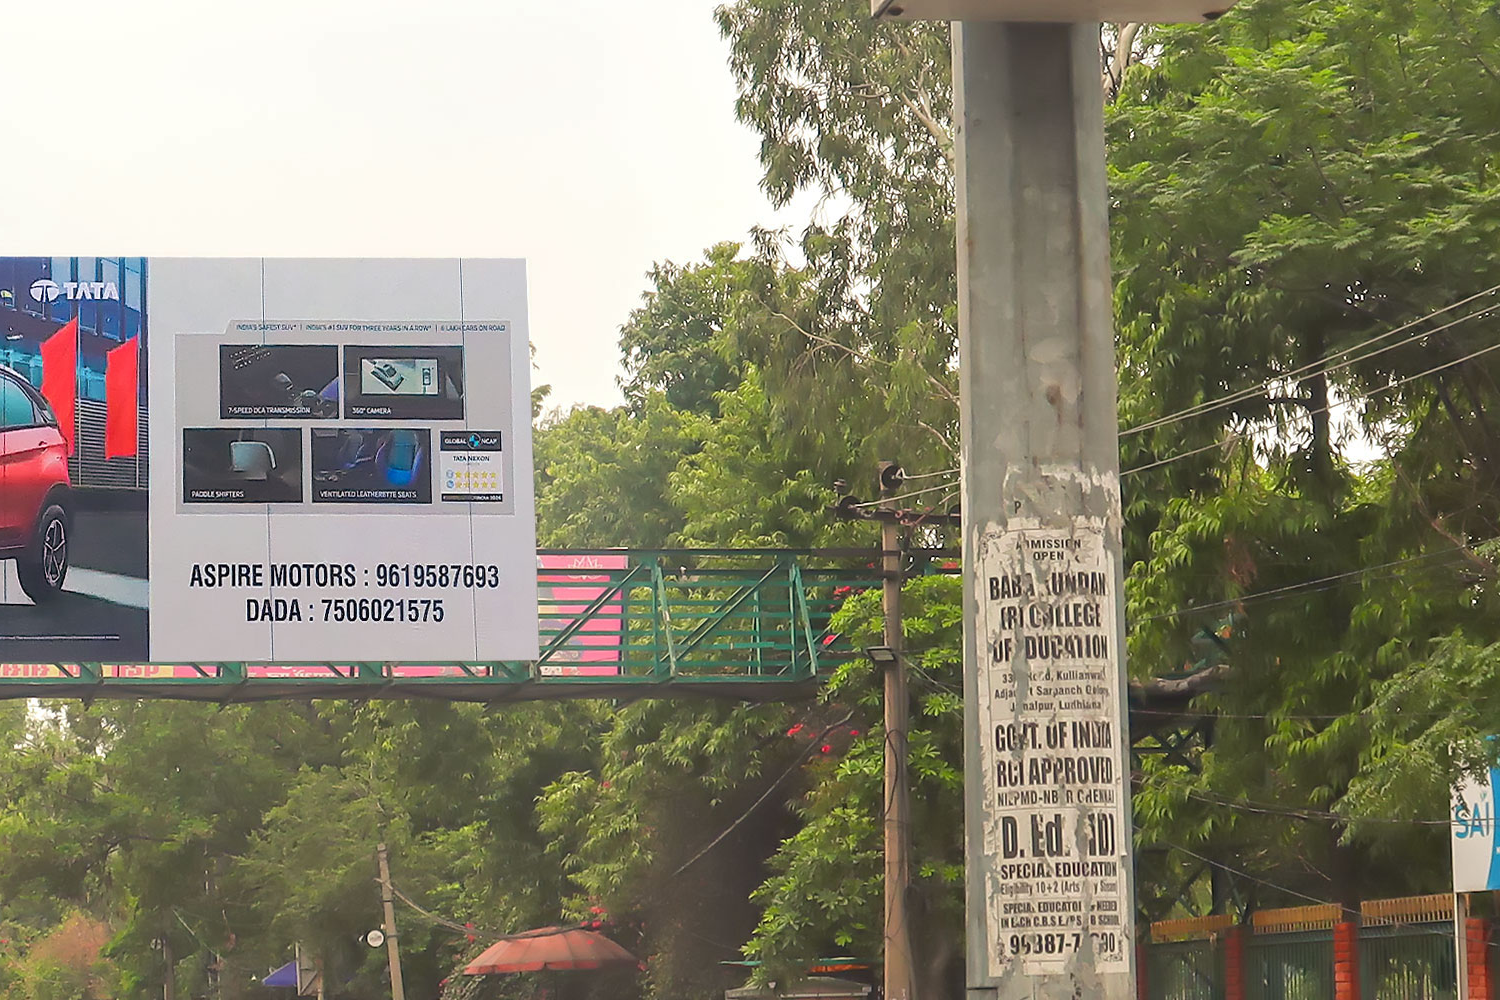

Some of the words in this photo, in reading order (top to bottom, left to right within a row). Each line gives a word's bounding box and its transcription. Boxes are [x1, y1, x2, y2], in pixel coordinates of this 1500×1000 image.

[63, 281, 119, 300] TATA
[191, 490, 215, 498] PADDLE
[215, 490, 244, 498] SHIFTERS
[1033, 551, 1064, 560] OPEN
[190, 564, 263, 587] ASPIRE
[270, 564, 356, 587] MOTORS
[376, 564, 500, 588] 9619587693
[1043, 571, 1106, 596] UNDAN
[247, 599, 302, 622] DADA
[321, 599, 444, 622] 7506021575
[993, 637, 1012, 663] OF
[1024, 634, 1108, 660] DUCATION
[1010, 700, 1056, 713] Jalpur,
[1046, 721, 1067, 750] OF
[1072, 721, 1112, 749] INDIA
[997, 759, 1024, 787] RCI
[1029, 756, 1113, 785] APPROVED
[998, 789, 1074, 807] NIPMD-NBR
[1002, 815, 1025, 859] D.
[1056, 861, 1117, 878] EDUCATION
[1001, 917, 1009, 928] IN
